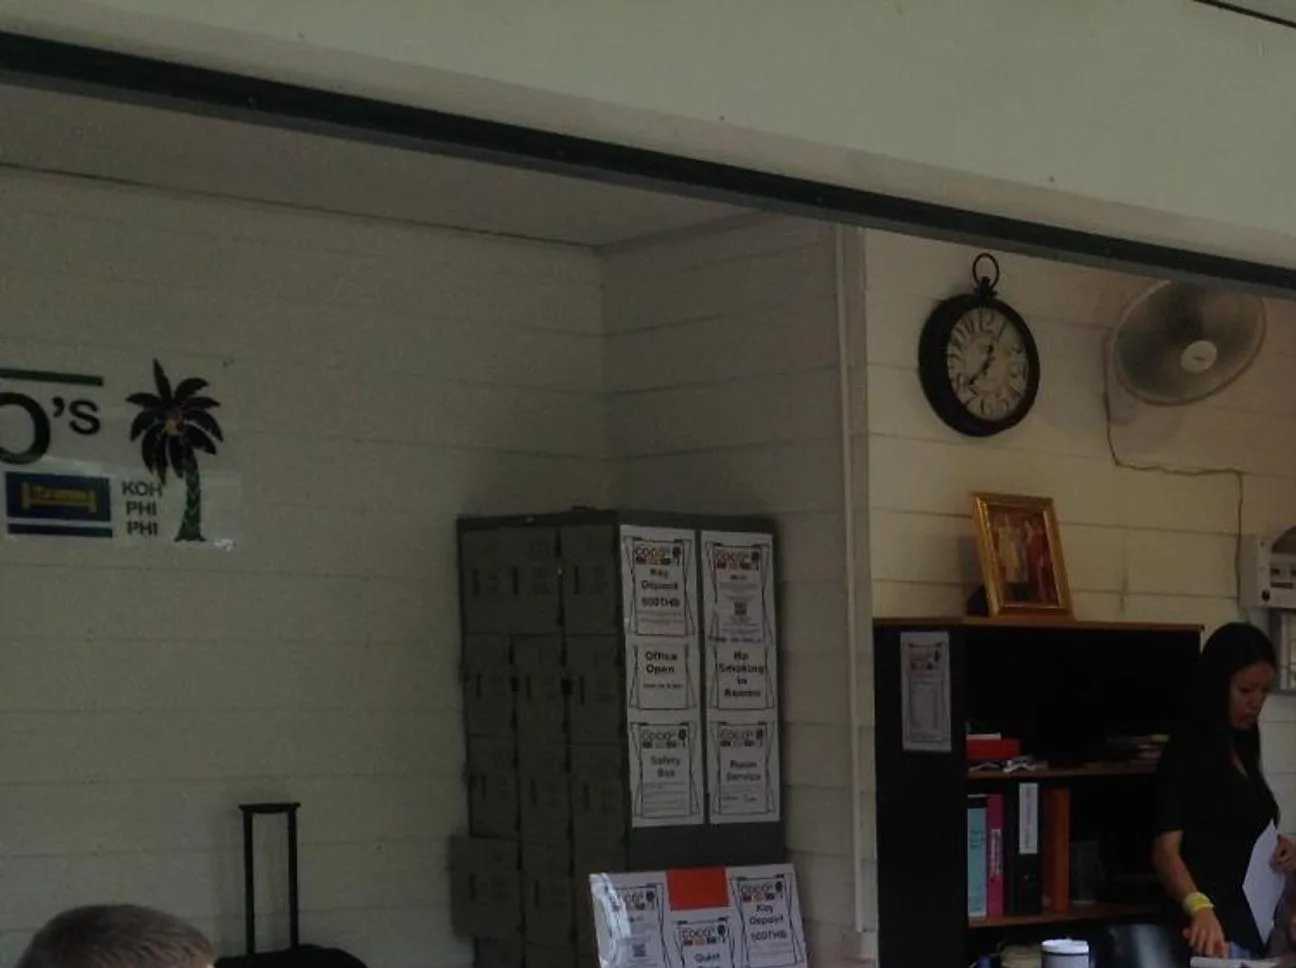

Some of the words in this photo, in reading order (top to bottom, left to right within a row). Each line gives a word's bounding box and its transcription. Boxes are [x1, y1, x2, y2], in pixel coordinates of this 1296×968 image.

[122, 481, 162, 497] KOH
[127, 501, 157, 516] PHI
[127, 521, 158, 536] PHI
[645, 651, 678, 661] Office
[734, 651, 750, 660] No
[646, 664, 675, 675] Open
[719, 663, 764, 673] Smoking
[650, 755, 681, 767] Safety
